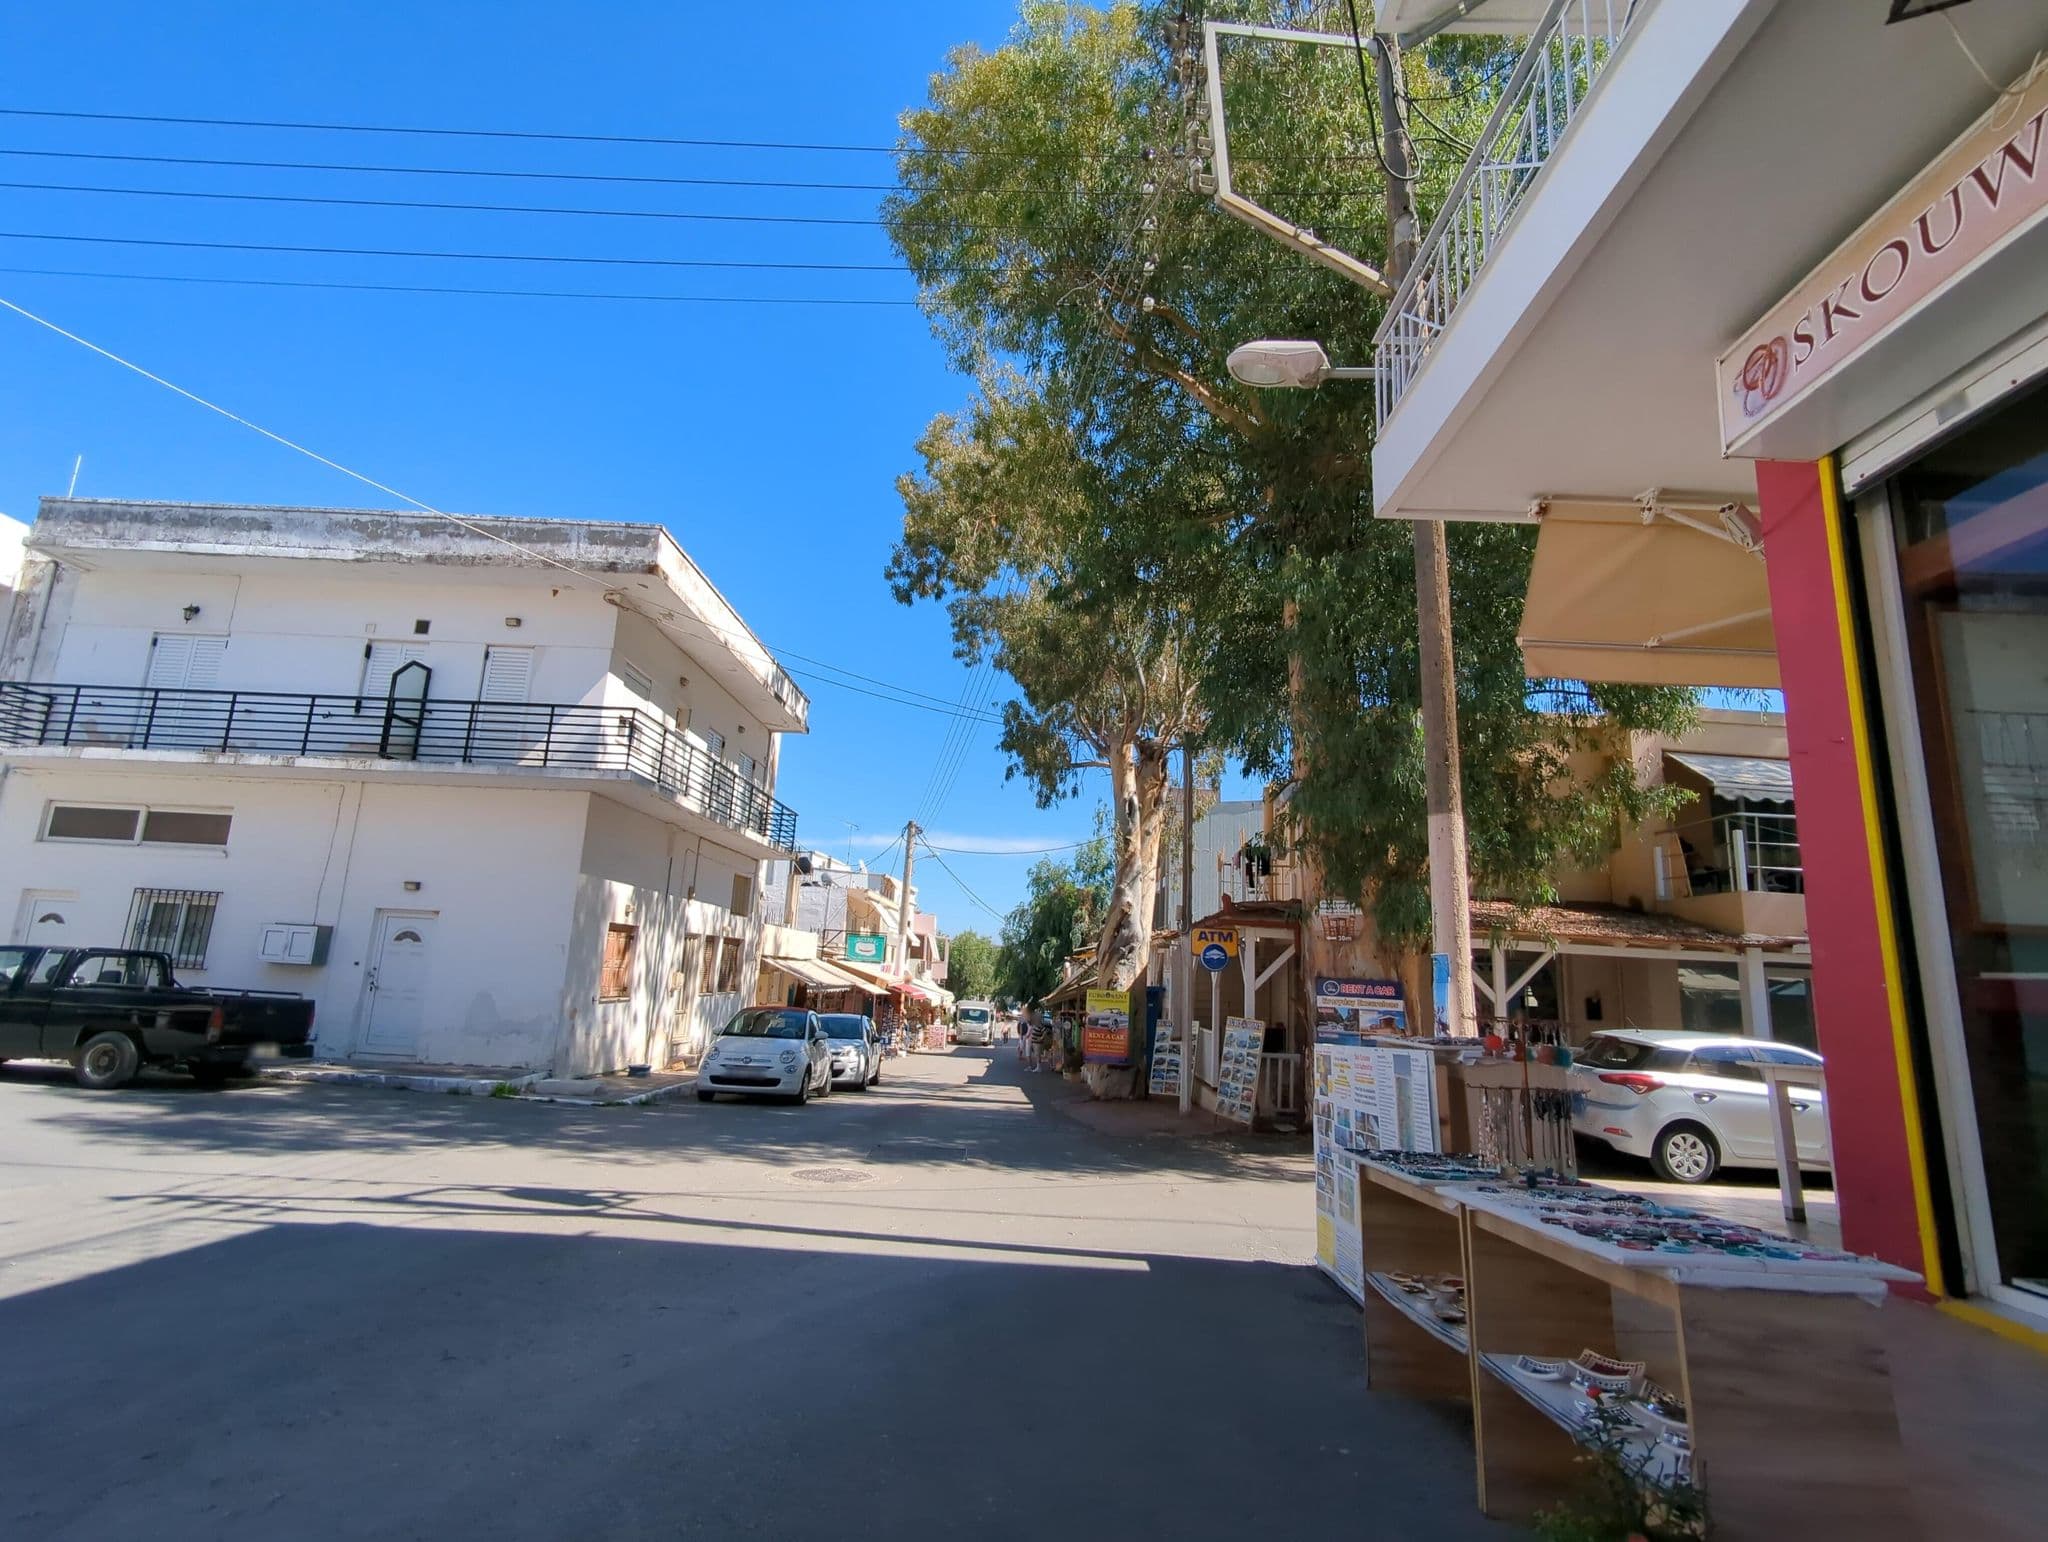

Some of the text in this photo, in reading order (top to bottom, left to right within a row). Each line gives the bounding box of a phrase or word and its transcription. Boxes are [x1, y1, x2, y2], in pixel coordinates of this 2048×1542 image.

[1197, 931, 1233, 942] ATM
[1340, 984, 1395, 996] RENT A CAR
[1088, 1032, 1105, 1040] RENT
